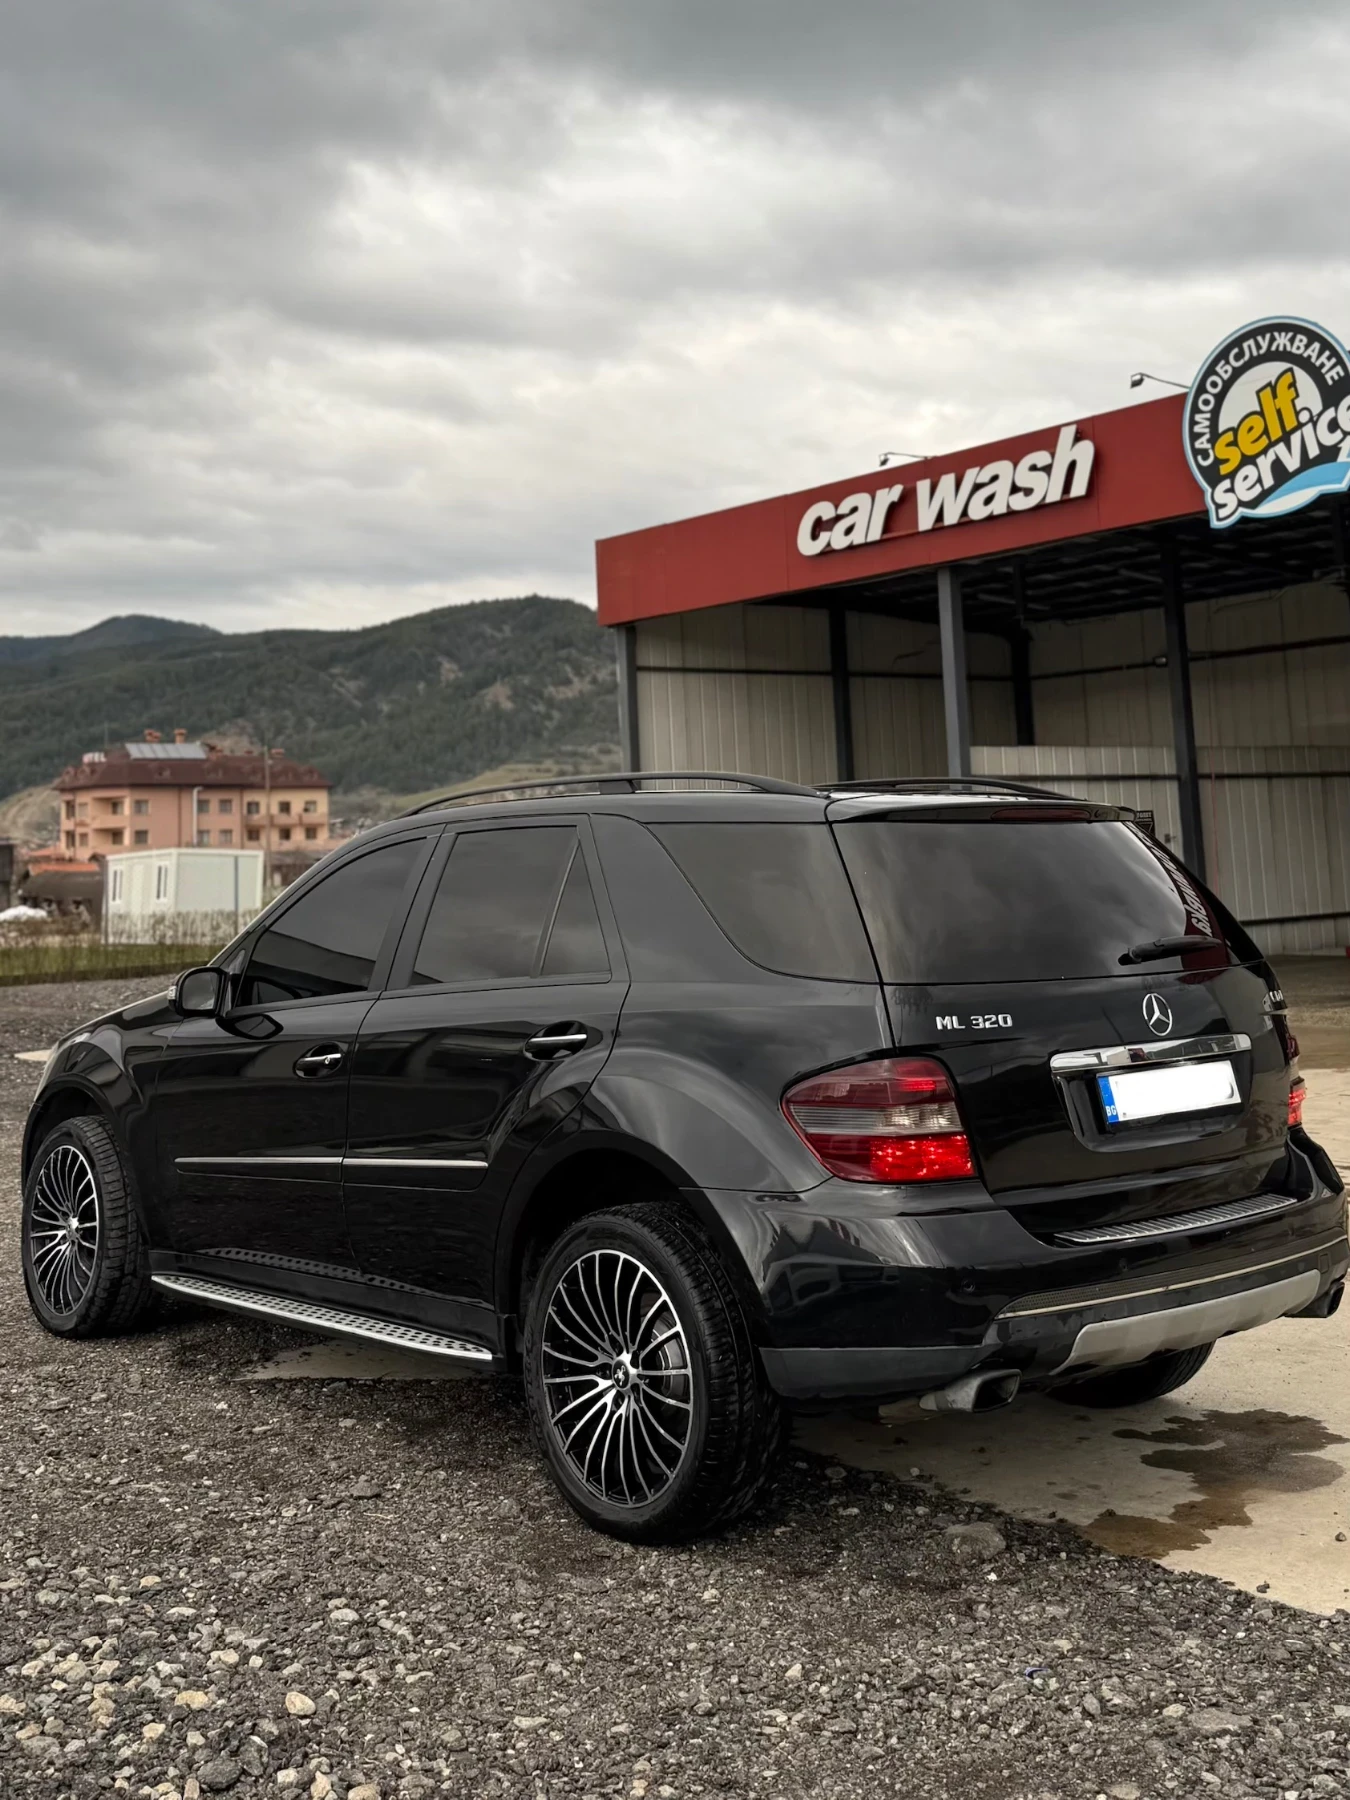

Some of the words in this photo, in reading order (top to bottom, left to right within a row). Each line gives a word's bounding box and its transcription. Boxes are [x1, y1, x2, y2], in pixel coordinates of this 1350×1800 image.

[1193, 331, 1345, 467] САМООБСЛУЖВАНЕ
[1214, 370, 1298, 476] self
[796, 484, 904, 556] car
[916, 423, 1096, 532] wash
[935, 1015, 966, 1030] ML
[970, 1013, 1013, 1029] 320
[1105, 1104, 1117, 1117] BG
